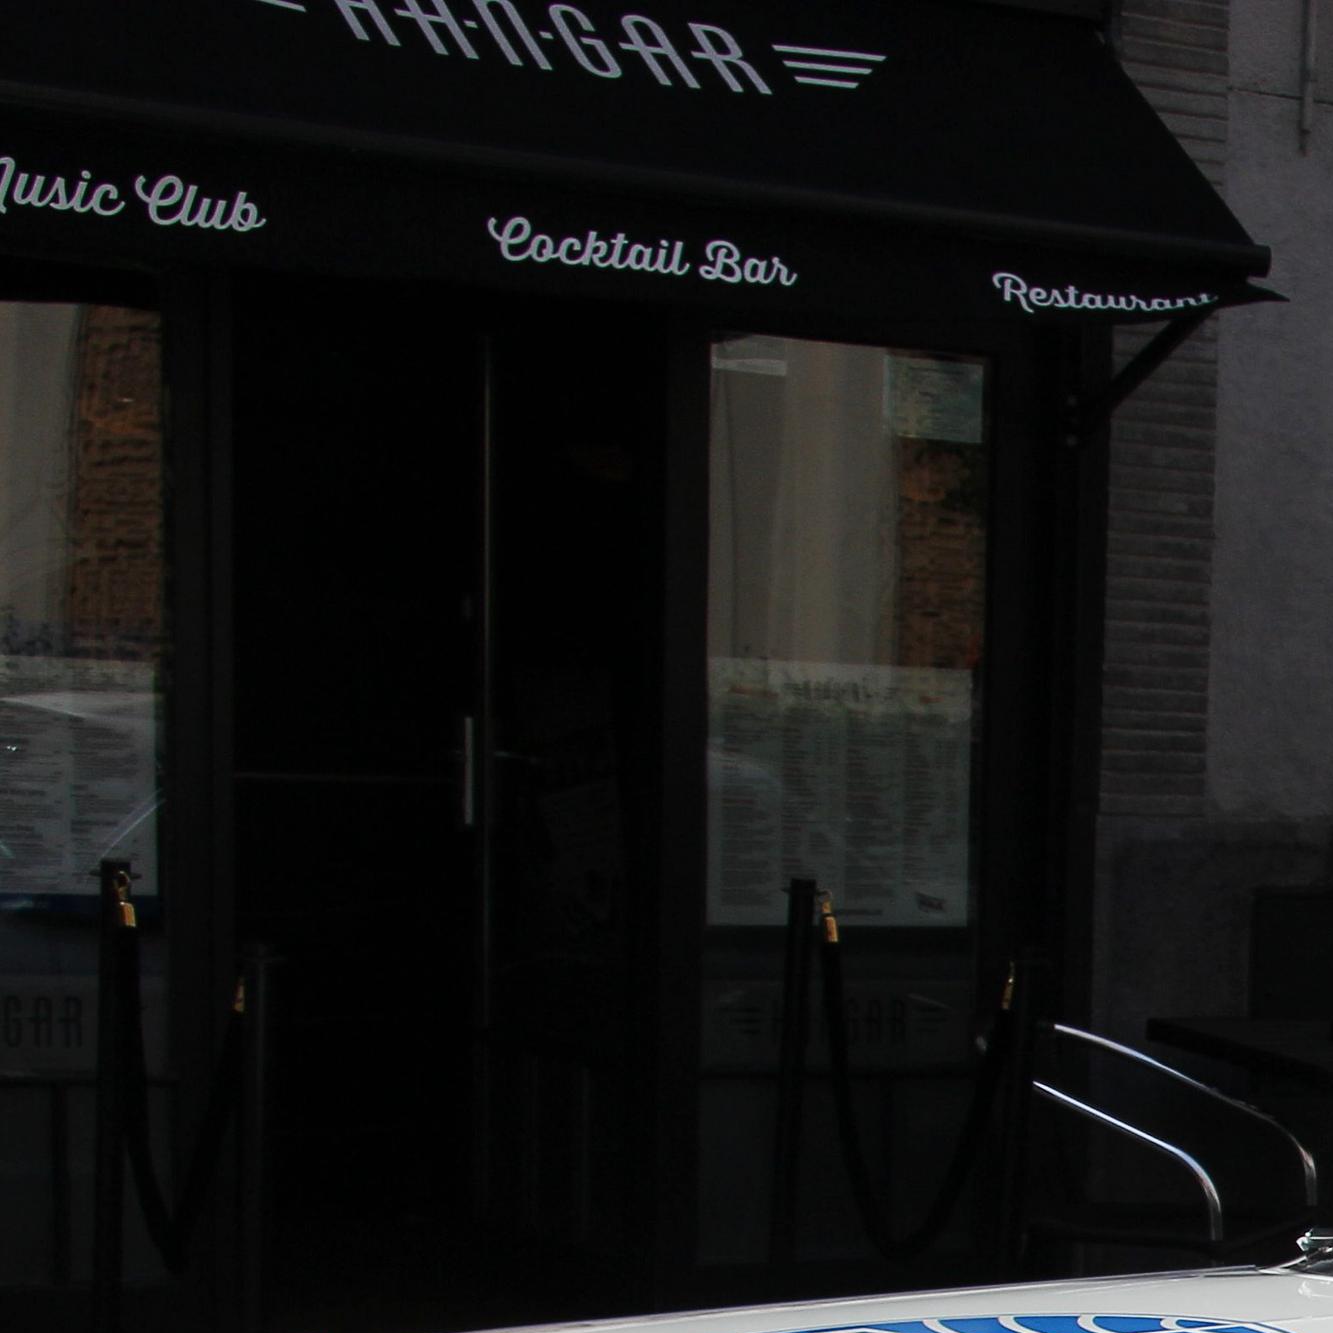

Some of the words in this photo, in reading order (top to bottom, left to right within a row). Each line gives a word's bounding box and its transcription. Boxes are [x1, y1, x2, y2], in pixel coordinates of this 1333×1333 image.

[135, 174, 266, 232] Club
[487, 216, 690, 276] Cocktail
[698, 241, 797, 286] Bar
[992, 272, 1219, 313] Restaurant
